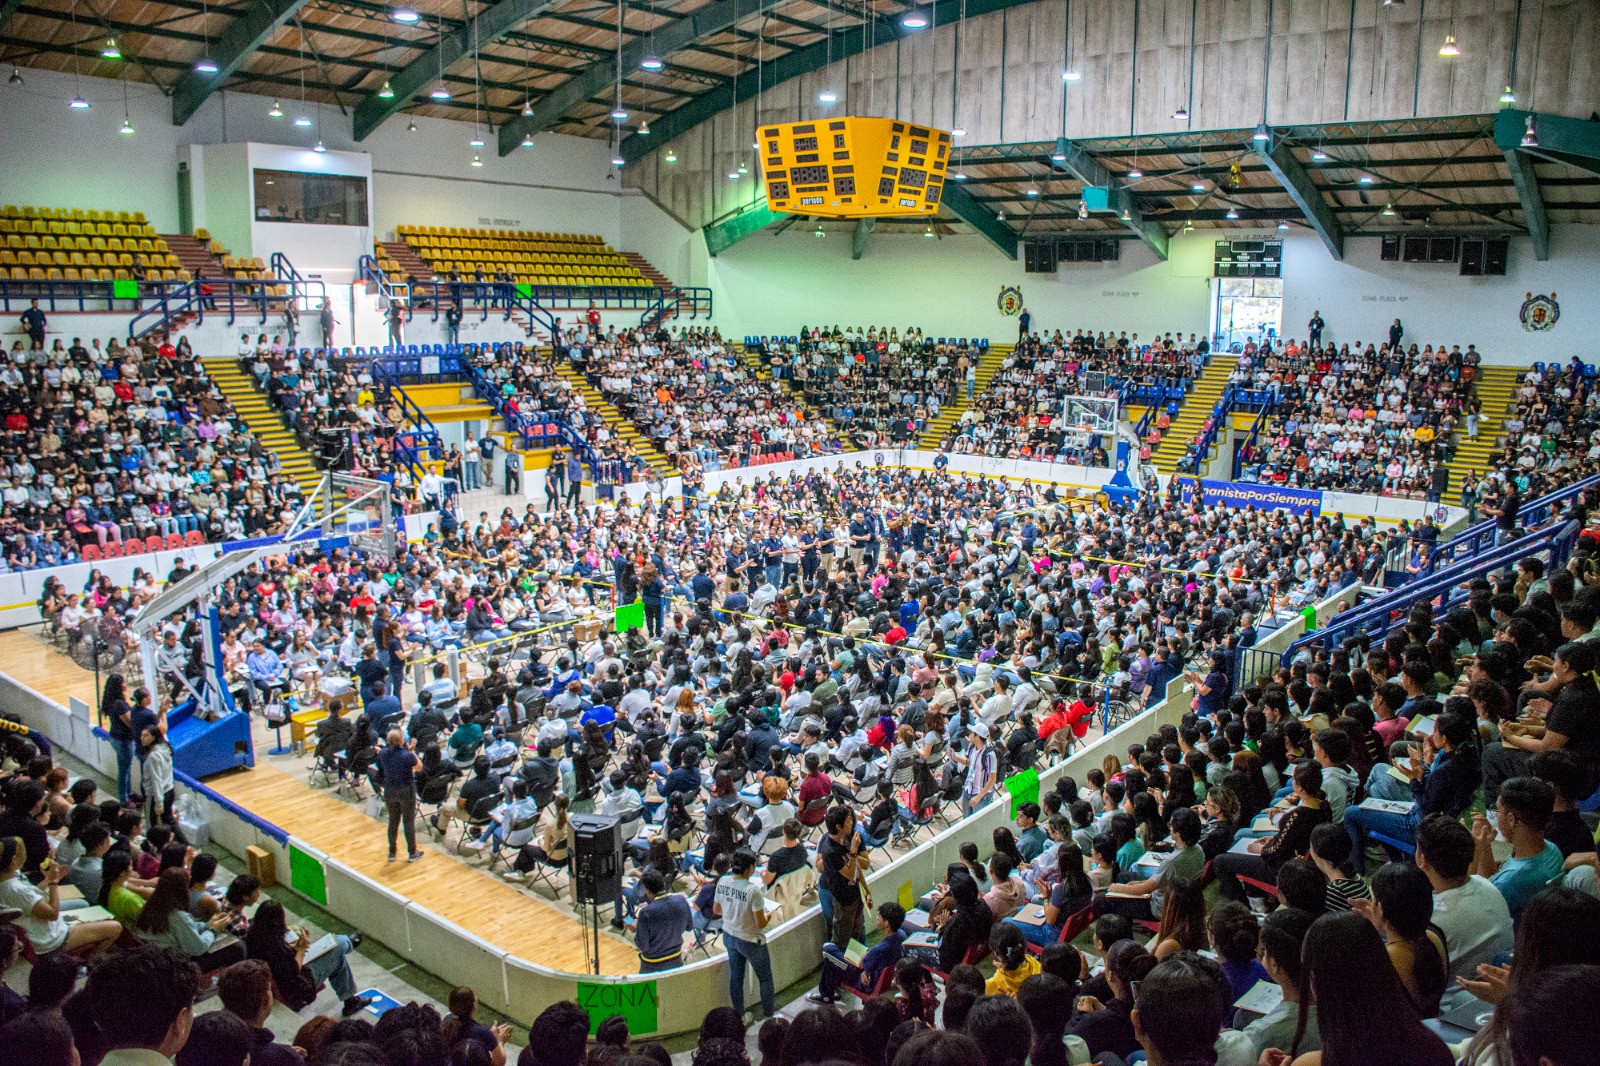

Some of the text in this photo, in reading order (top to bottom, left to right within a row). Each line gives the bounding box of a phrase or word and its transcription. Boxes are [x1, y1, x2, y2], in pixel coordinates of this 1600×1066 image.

[1182, 484, 1320, 507] HanistaPorSiempre
[731, 888, 747, 902] PINK
[582, 983, 656, 1008] ZONA
